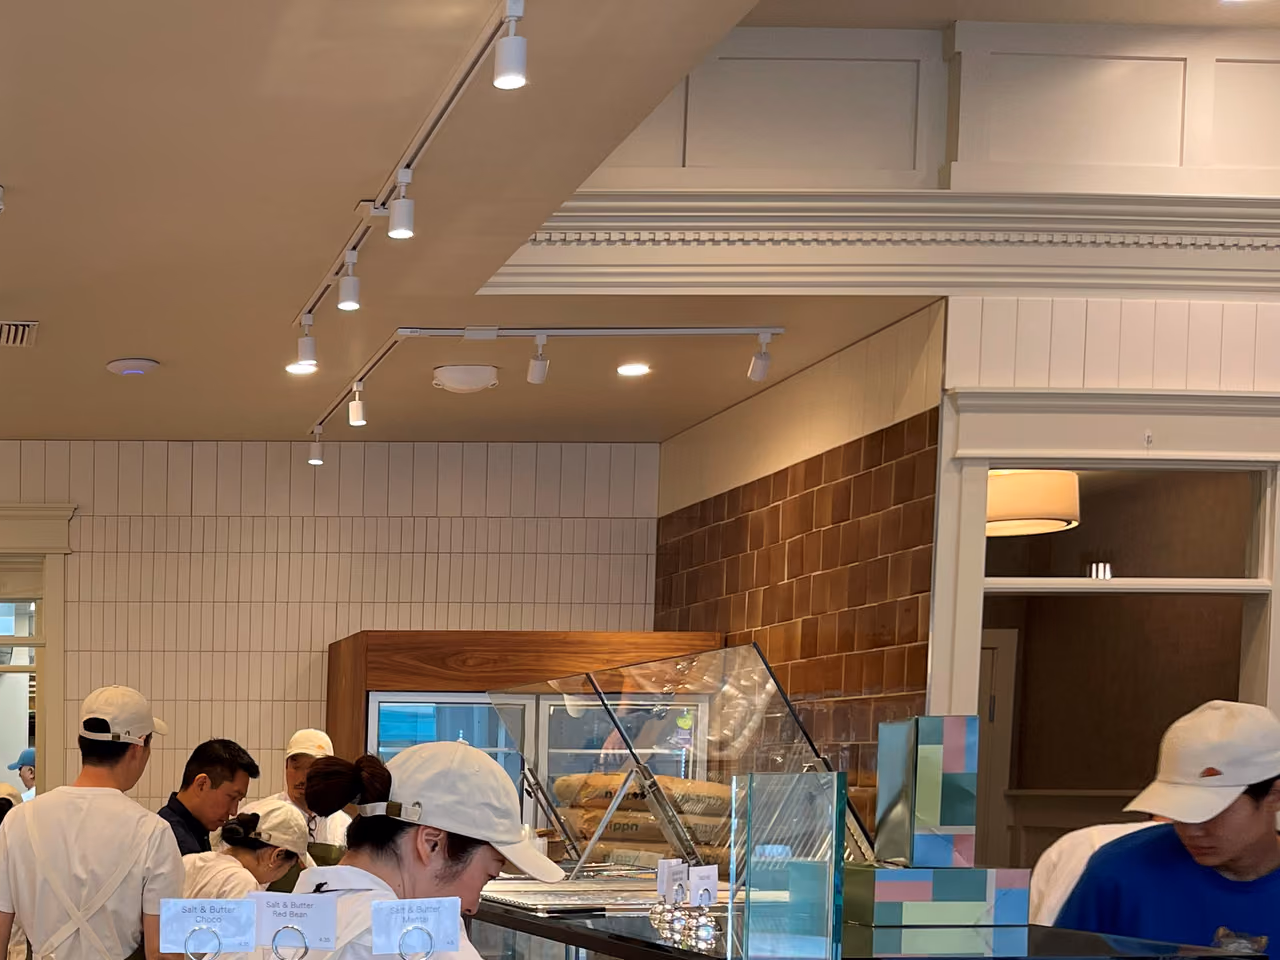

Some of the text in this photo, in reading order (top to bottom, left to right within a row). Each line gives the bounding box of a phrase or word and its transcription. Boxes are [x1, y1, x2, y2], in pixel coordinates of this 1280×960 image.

[266, 901, 314, 909] Salt & Butter
[181, 905, 237, 914] Salt & Butter
[273, 910, 287, 918] Red
[195, 915, 223, 924] Choco
